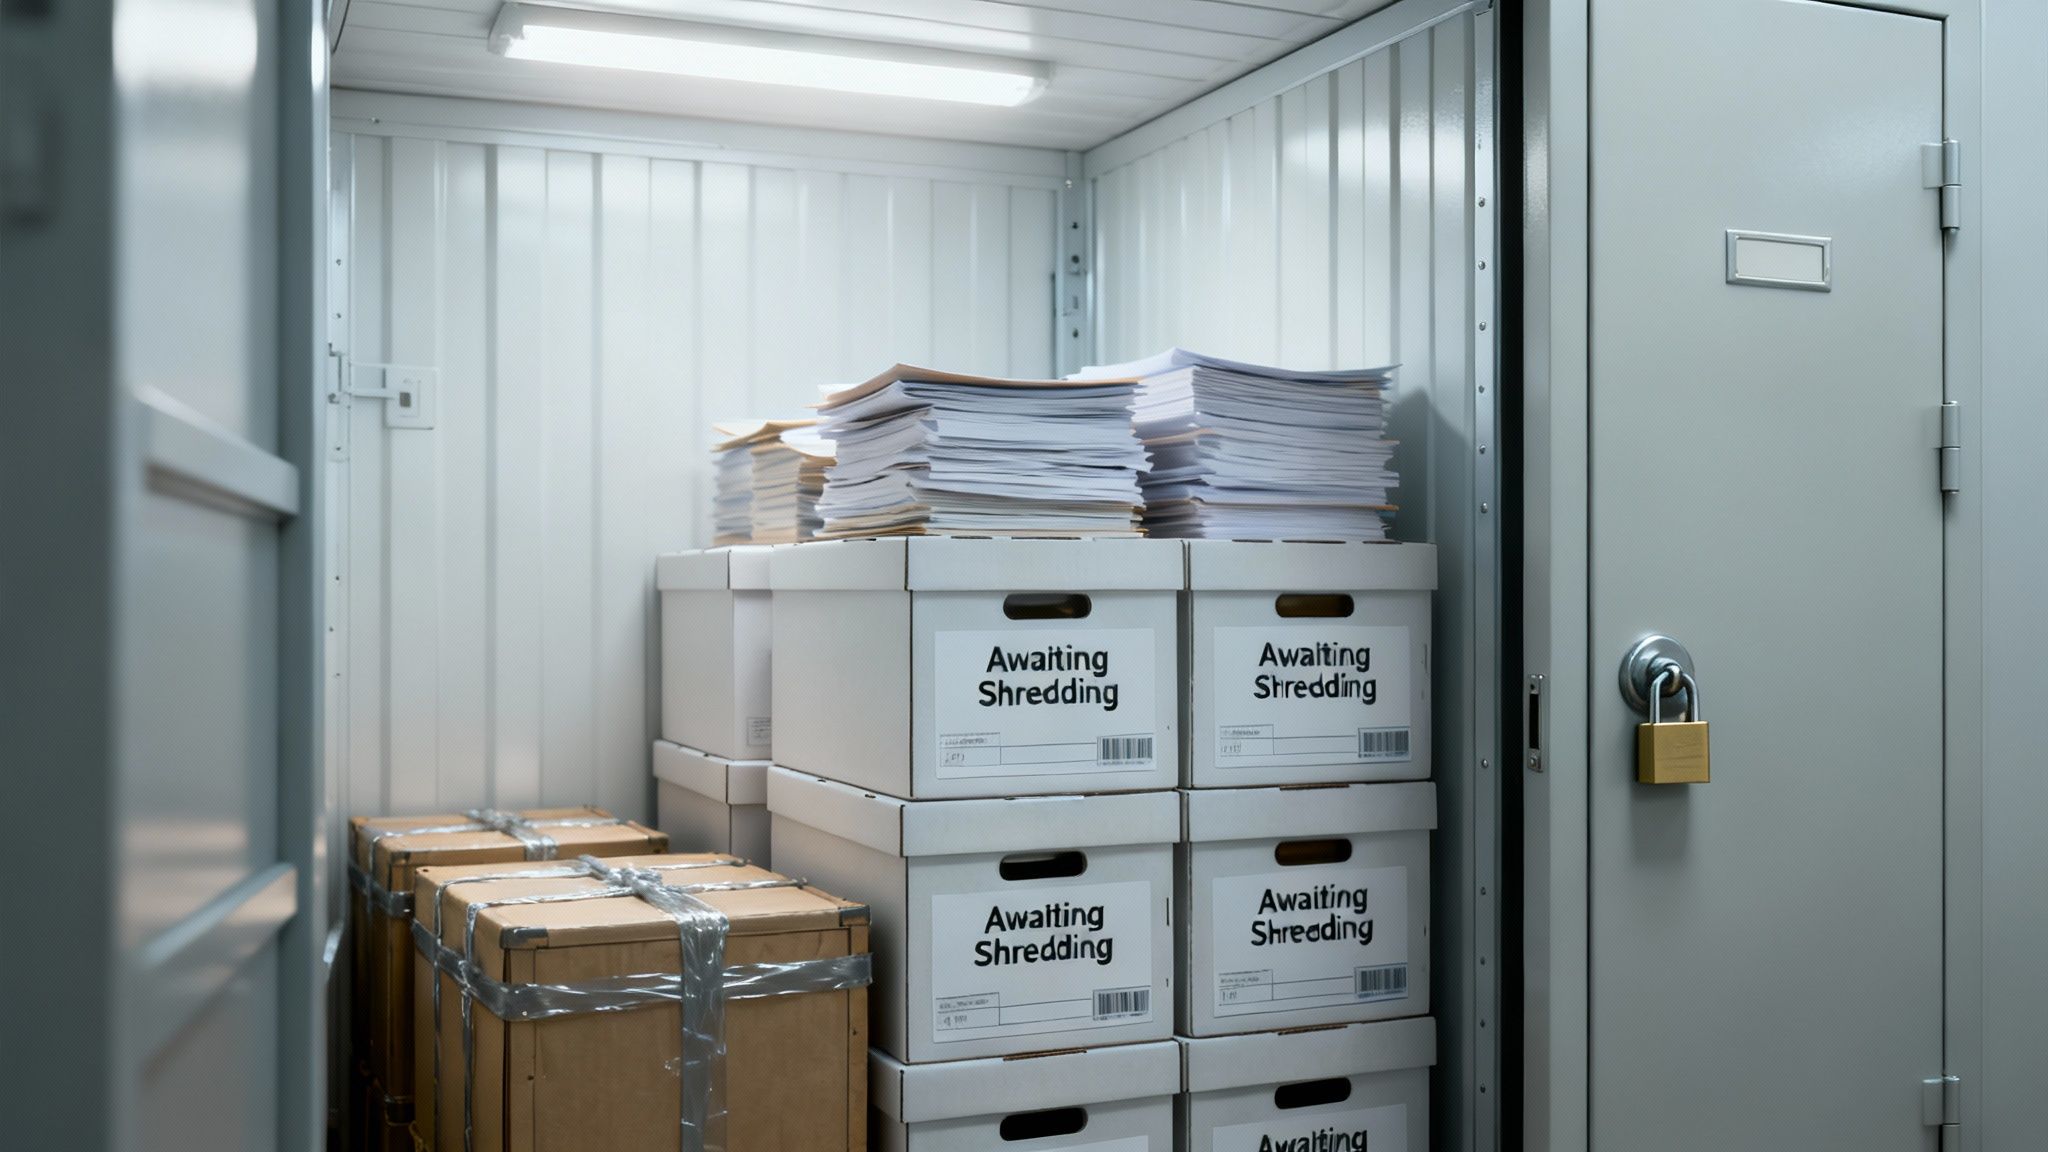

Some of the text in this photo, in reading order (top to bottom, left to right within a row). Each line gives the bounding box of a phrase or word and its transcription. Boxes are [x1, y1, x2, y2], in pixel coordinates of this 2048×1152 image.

[986, 644, 1108, 677] Awaiting
[978, 678, 1118, 711] Shredding
[1258, 884, 1368, 915] Awaiting
[984, 902, 1104, 933] Awaiting
[974, 934, 1113, 966] Shredding
